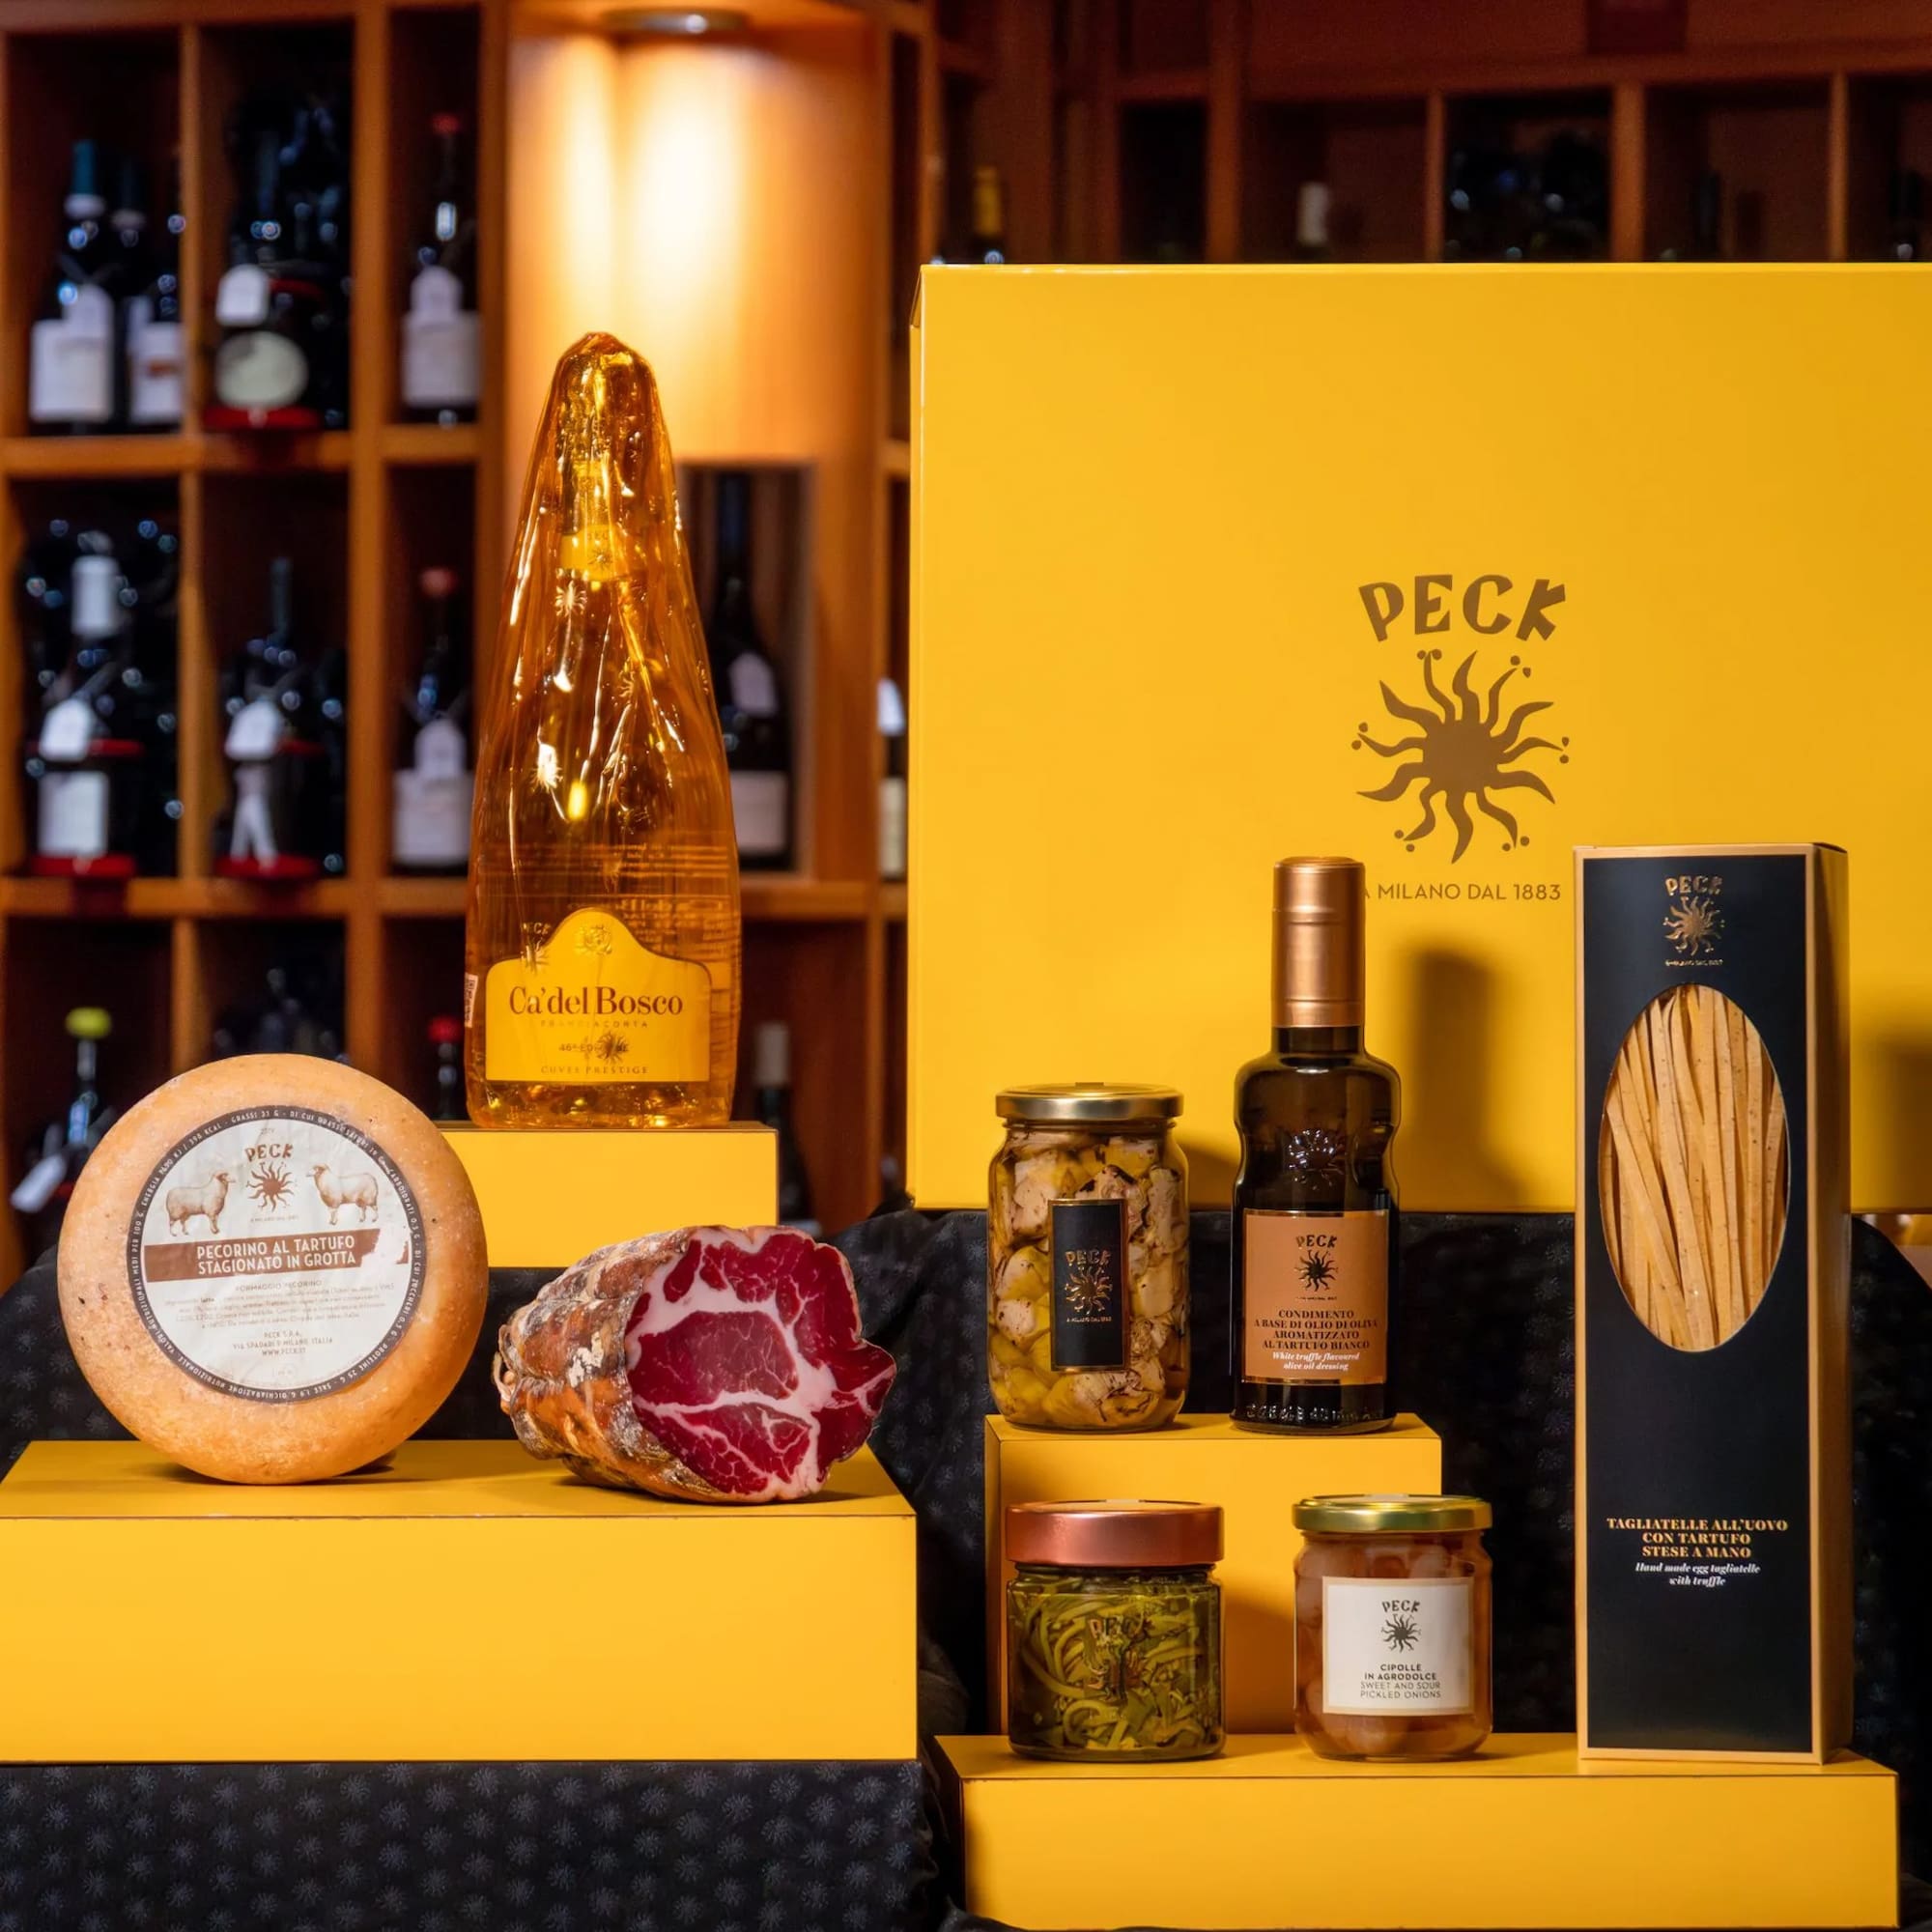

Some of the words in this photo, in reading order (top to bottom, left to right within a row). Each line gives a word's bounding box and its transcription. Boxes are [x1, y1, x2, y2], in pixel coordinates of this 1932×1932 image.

[1358, 573, 1566, 642] PECK
[1378, 883, 1461, 900] MILANO
[1467, 883, 1507, 900] DAL
[1513, 883, 1561, 901] 1883
[1664, 875, 1722, 896] PECK
[595, 986, 683, 1015] Bosco
[585, 1065, 648, 1074] PRESTIGE
[230, 1111, 257, 1124] GRASSI
[299, 1112, 314, 1122] CUI
[203, 1122, 222, 1135] KCAL
[244, 1143, 294, 1162] PECK
[139, 1175, 160, 1207] ENERGIA
[131, 1219, 142, 1235] 100
[130, 1237, 139, 1252] PER
[196, 1241, 268, 1260] PECORINO
[272, 1239, 290, 1254] AL
[293, 1235, 355, 1253] TARTUFO
[1296, 1234, 1338, 1248] PECK
[198, 1256, 282, 1275] STAGIONATO
[287, 1255, 300, 1268] IN
[303, 1250, 356, 1267] GROTTA
[1065, 1250, 1111, 1266] PECK
[130, 1256, 139, 1275] MEDI
[413, 1261, 422, 1275] CUI
[402, 1277, 420, 1316] ZUCCHERI
[1278, 1310, 1354, 1319] CONDIMENTO
[1262, 1320, 1288, 1328] BASE
[1290, 1320, 1302, 1329] DI
[1304, 1320, 1333, 1329] OLIO
[1336, 1320, 1347, 1329] DI
[1350, 1319, 1378, 1328] OLIVA
[1273, 1330, 1360, 1340] AROMATIZZATO
[1264, 1340, 1275, 1349] AL
[1276, 1340, 1327, 1350] TARTUFO
[1330, 1340, 1370, 1350] BIANCO
[357, 1342, 388, 1372] PROTEINE
[1272, 1351, 1294, 1360] White
[1295, 1352, 1322, 1362] truffle
[1321, 1352, 1360, 1362] flavoured
[1283, 1361, 1302, 1370] olive
[1315, 1362, 1350, 1371] dressing
[313, 1381, 331, 1394] SALE
[1606, 1518, 1709, 1531] TAGLIATELLE
[1711, 1519, 1789, 1532] ALL'UOVO
[1642, 1532, 1674, 1544] CON
[1678, 1532, 1751, 1545] TARTUFO
[1642, 1546, 1690, 1558] STESE
[1692, 1547, 1703, 1558] A
[1705, 1547, 1752, 1558] MANO
[1635, 1562, 1663, 1573] Hand
[1664, 1563, 1690, 1574] made
[1691, 1565, 1709, 1575] egg
[1710, 1563, 1761, 1575] tagliatelle
[1669, 1576, 1691, 1586] with
[1692, 1576, 1726, 1588] truffle
[1381, 1600, 1421, 1613] PECK
[1404, 1690, 1441, 1699] ONIONS
